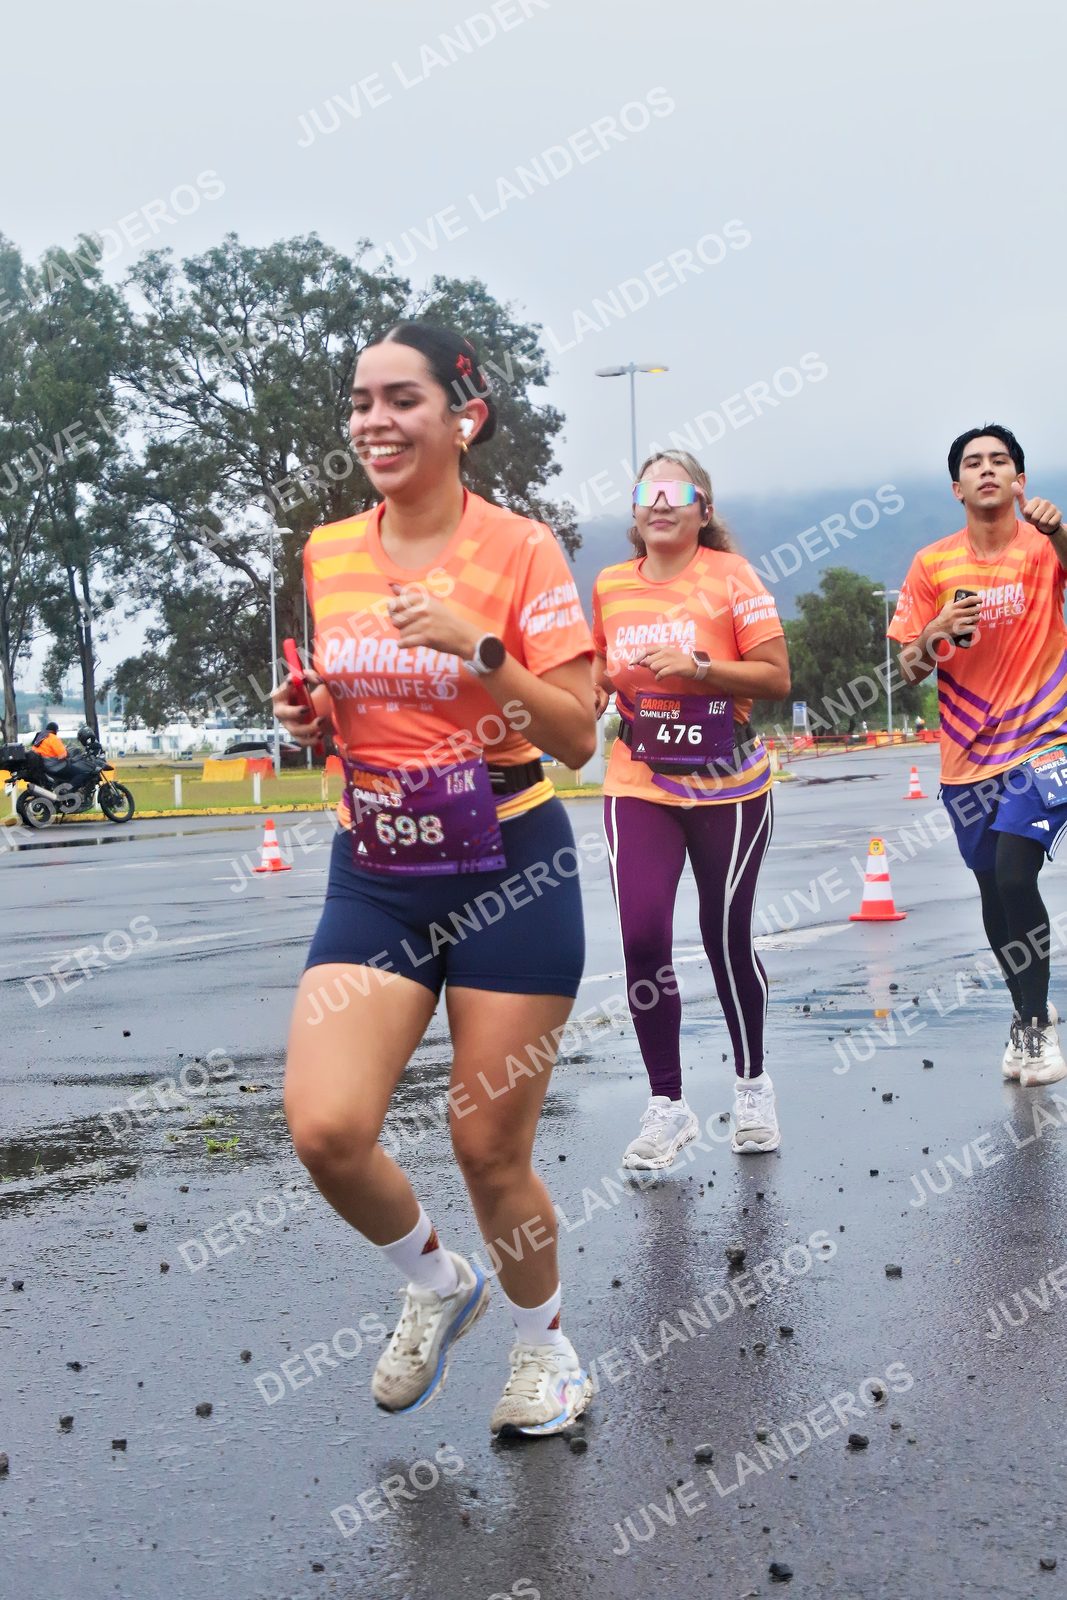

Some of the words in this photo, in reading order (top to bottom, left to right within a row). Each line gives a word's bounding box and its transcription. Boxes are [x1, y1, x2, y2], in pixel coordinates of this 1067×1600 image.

[977, 582, 1025, 608] RRERA
[979, 605, 1011, 621] NILIFE
[616, 620, 695, 647] CARRERA
[323, 637, 460, 674] CARRERA
[329, 677, 428, 701] OMNILIFE
[640, 698, 681, 711] CARRERA
[640, 709, 671, 720] OMNILIFE
[656, 723, 704, 745] 476
[375, 812, 445, 847] 698
